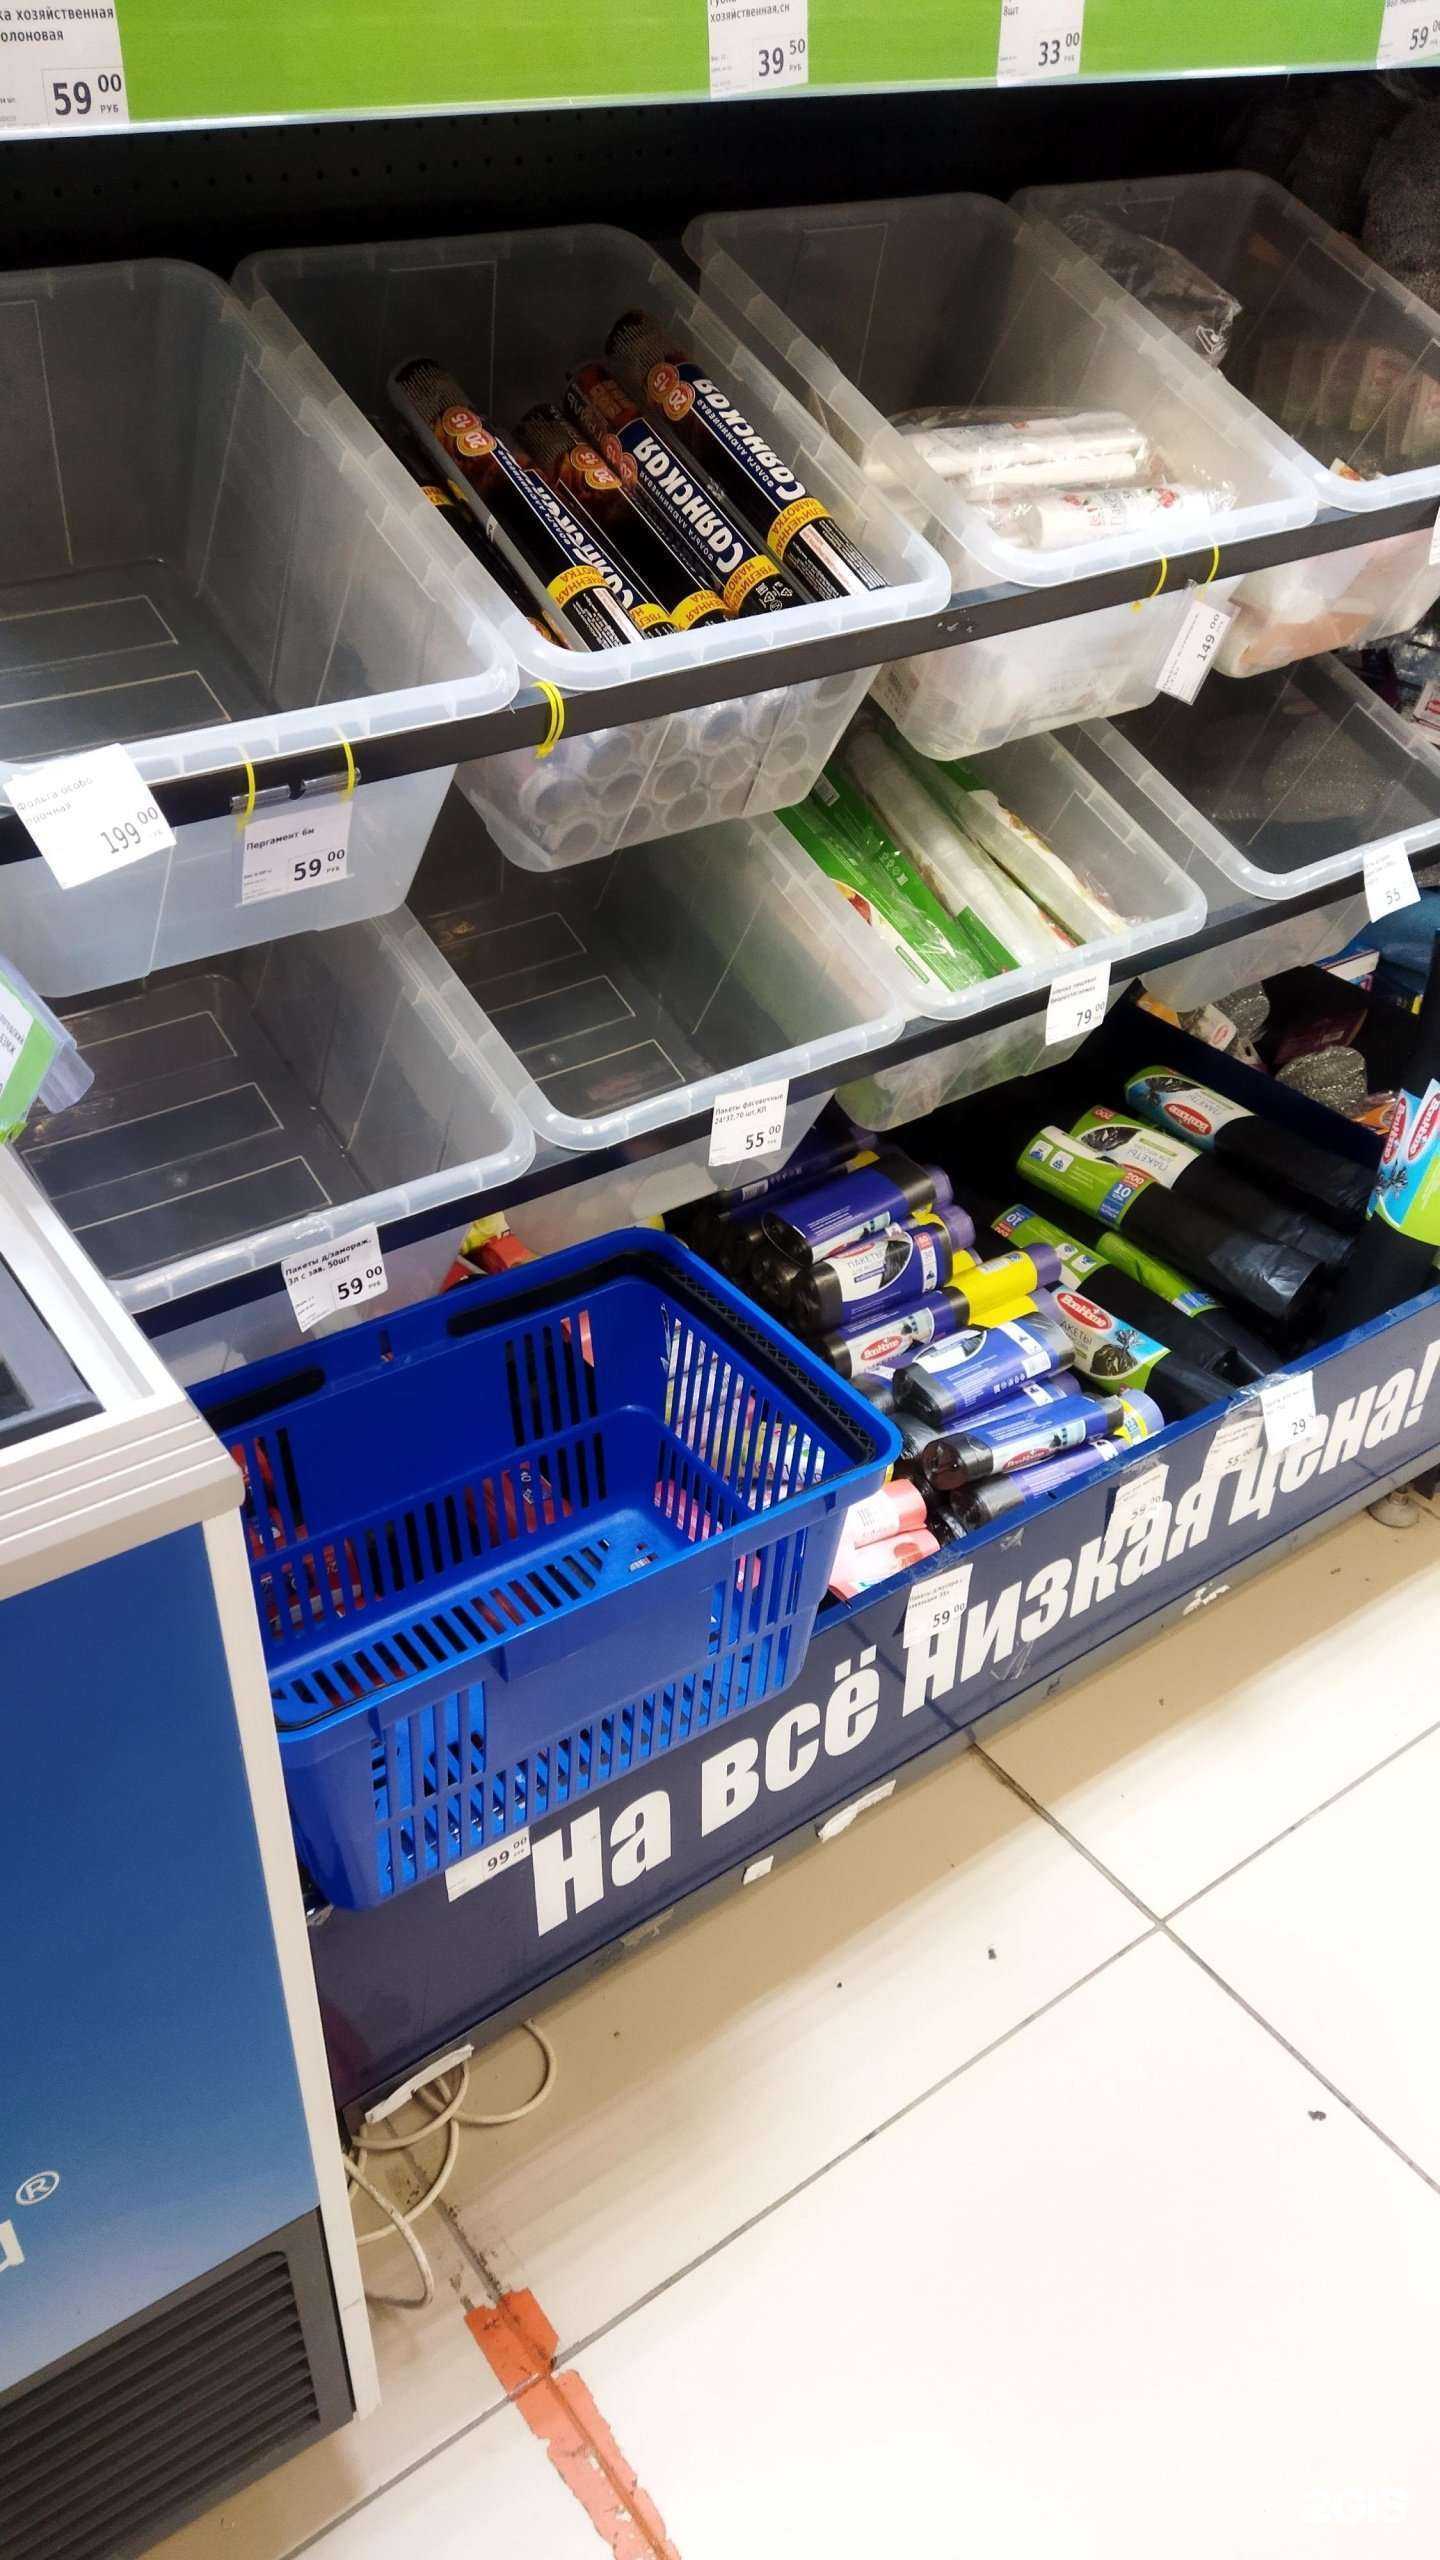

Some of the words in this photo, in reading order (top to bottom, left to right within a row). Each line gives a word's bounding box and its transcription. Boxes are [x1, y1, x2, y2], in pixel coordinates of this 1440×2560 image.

[16, 6, 114, 21] хозяйственная
[0, 30, 64, 42] олоновая
[1409, 26, 1429, 50] 59
[758, 47, 784, 77] 39
[789, 38, 806, 56] 50
[1038, 40, 1061, 66] 33
[1065, 32, 1080, 48] 00
[52, 81, 92, 116] 59
[98, 73, 122, 93] 00
[100, 104, 119, 113] РУБ
[632, 436, 744, 574] Саянская
[1196, 634, 1216, 663] 149
[17, 791, 59, 813] Фольга
[26, 803, 73, 827] прочная
[100, 822, 142, 855] 199
[137, 806, 159, 825] 00
[246, 833, 299, 851] Пергамент
[294, 858, 322, 881] 59
[327, 849, 345, 862] 00
[1076, 1009, 1092, 1027] 79
[745, 1131, 765, 1151] 55
[768, 1123, 782, 1136] 00
[1113, 1184, 1132, 1198] 10
[285, 1258, 319, 1276] Пакеты
[337, 1277, 363, 1300] 59
[365, 1265, 383, 1279] 00
[1291, 1418, 1306, 1436] 29
[933, 1610, 950, 1628] 59
[531, 1789, 672, 1937] На
[701, 1644, 881, 1838] всё
[487, 1850, 510, 1872] 99
